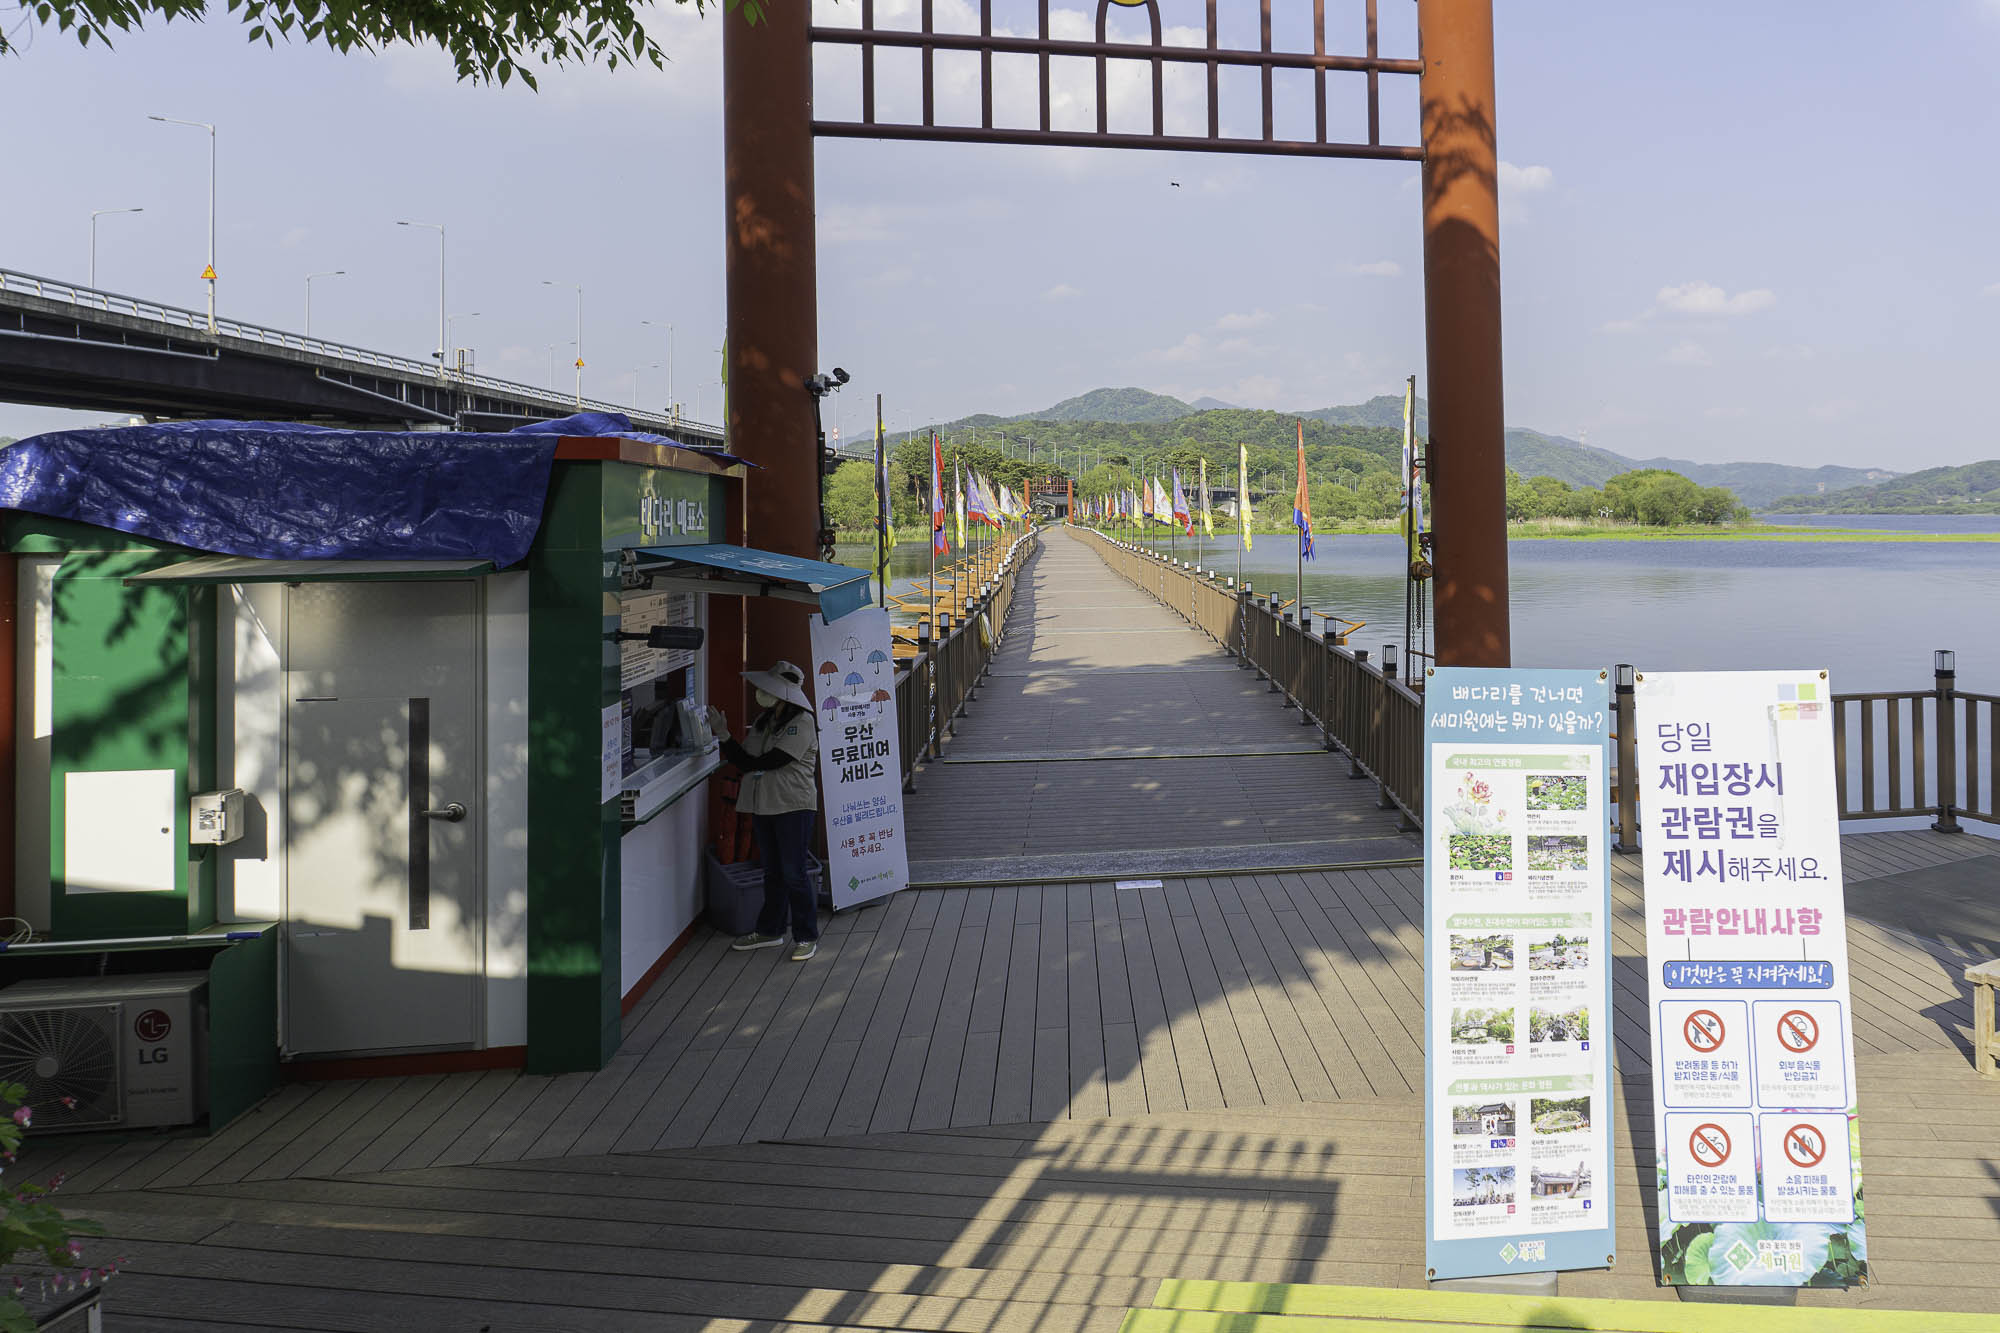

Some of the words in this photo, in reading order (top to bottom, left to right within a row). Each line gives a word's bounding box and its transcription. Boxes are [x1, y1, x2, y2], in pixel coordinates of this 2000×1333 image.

[640, 496, 673, 536] 배다리
[676, 498, 704, 536] 매표소
[1452, 684, 1523, 705] 배다리를
[1529, 686, 1584, 704] 건너면
[1431, 710, 1508, 732] 세미원에는
[1512, 711, 1544, 730] 뭐가
[1548, 711, 1604, 734] 있을까?
[845, 723, 874, 743] 우산
[1658, 722, 1712, 752] 당일
[832, 740, 889, 765] 무료대여
[840, 761, 884, 783] 서비스
[1659, 762, 1784, 796] 재입장시
[872, 795, 886, 806] 양심
[832, 814, 853, 826] 우산을
[1661, 806, 1780, 840] 관람권을
[841, 838, 855, 849] 사용
[858, 835, 865, 844] 후
[869, 832, 875, 841] 꼭
[879, 828, 893, 839] 반납
[852, 843, 884, 857] 해주세요.
[1662, 849, 1828, 883] 제시해주세요.
[1663, 907, 1823, 936] 관람안내사항
[1672, 964, 1727, 985] 이것만은
[1731, 967, 1743, 984] 꼭
[1747, 964, 1824, 985] 지켜주세요!
[139, 1048, 168, 1064] LG
[1676, 1061, 1708, 1070] 반려동물
[1711, 1061, 1719, 1070] 등
[1722, 1061, 1738, 1069] 허가
[1779, 1061, 1795, 1070] 외부
[1797, 1061, 1820, 1070] 음식물
[1784, 1072, 1818, 1081] 반입금지
[1786, 1175, 1802, 1184] 소음
[1804, 1175, 1828, 1184] 피해를
[1674, 1185, 1697, 1195] 피해를
[1700, 1185, 1707, 1195] 줄
[1710, 1186, 1718, 1194] 수
[1720, 1186, 1736, 1196] 있는
[1778, 1186, 1818, 1196] 발생시키는
[1759, 1252, 1801, 1272] 세미원
